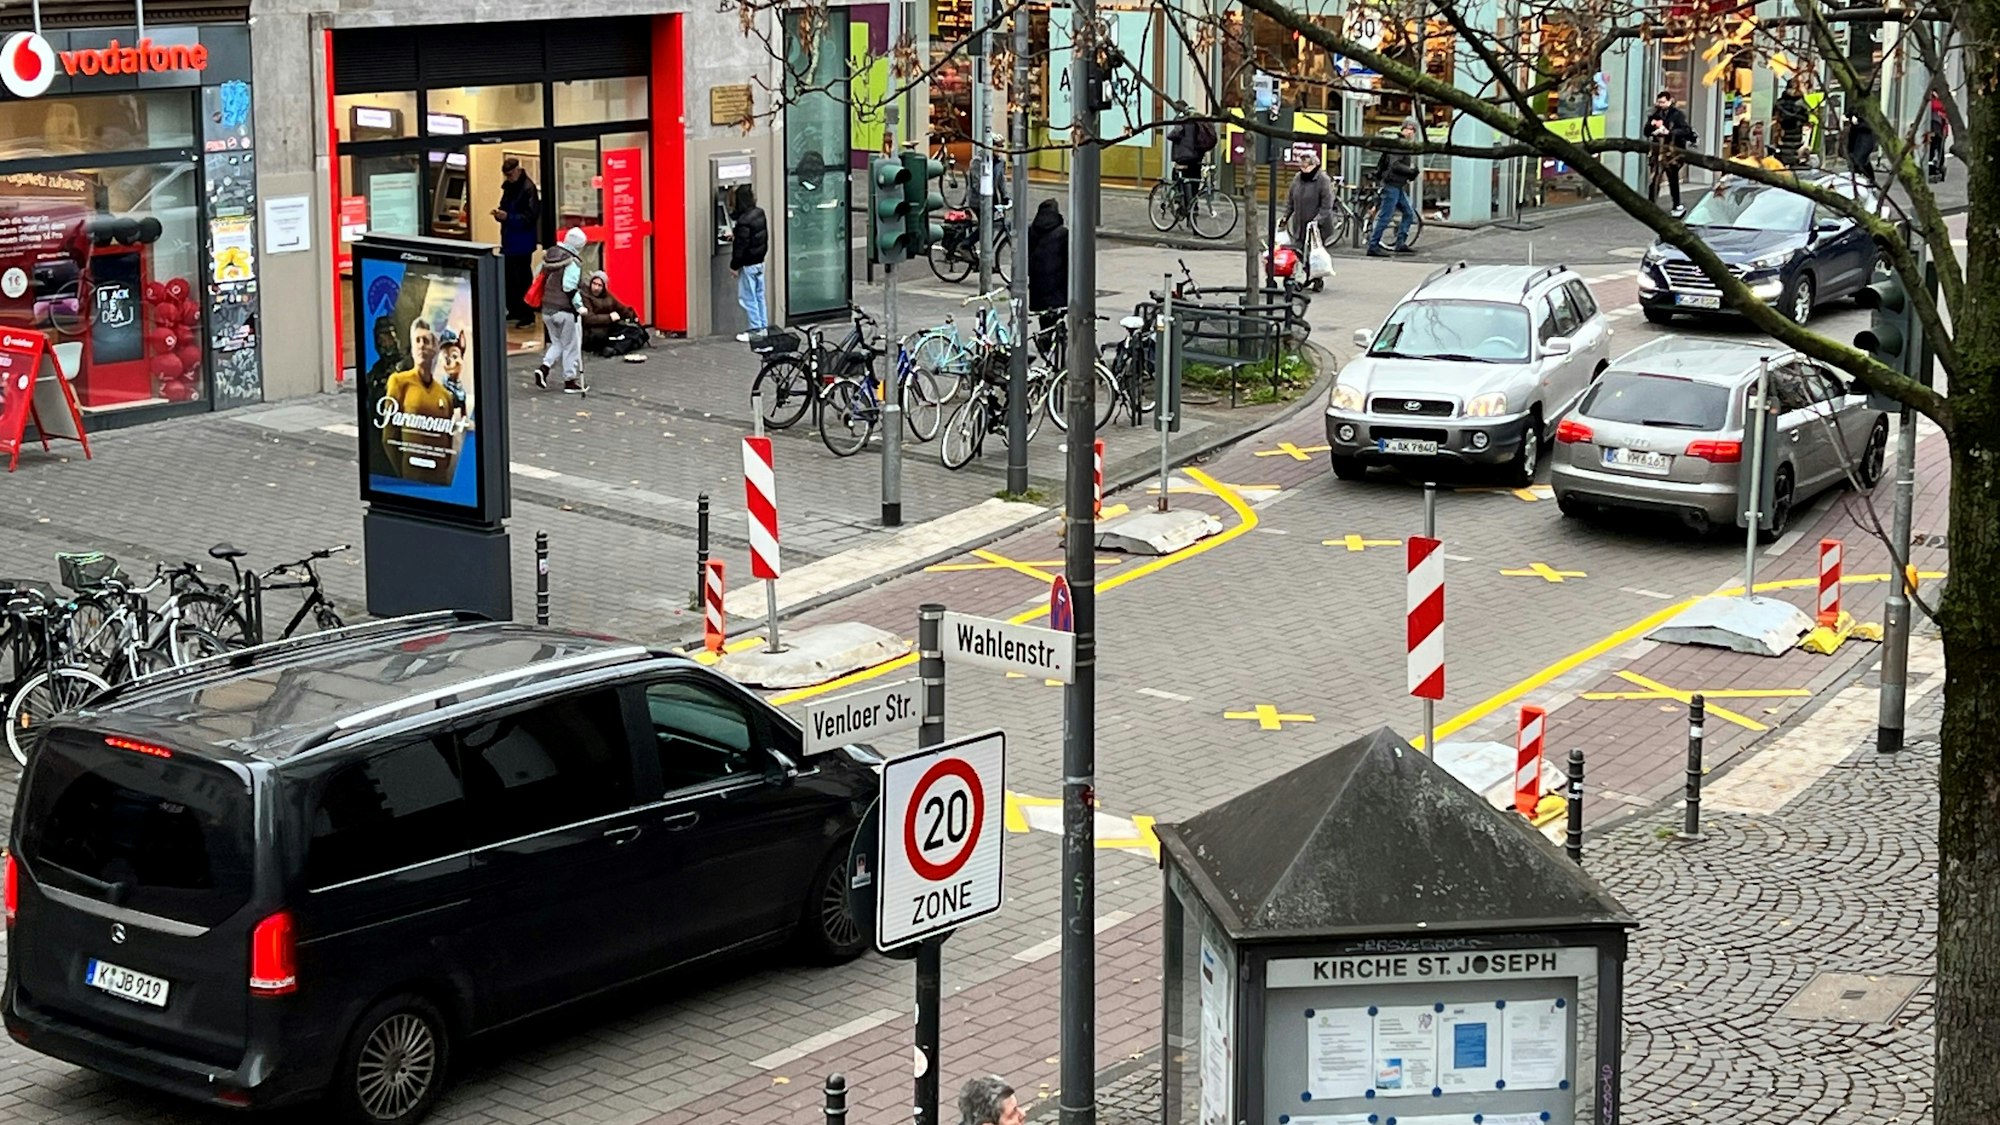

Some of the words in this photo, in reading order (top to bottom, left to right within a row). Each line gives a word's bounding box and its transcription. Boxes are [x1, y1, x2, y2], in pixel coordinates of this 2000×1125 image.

[1353, 18, 1375, 39] 30
[60, 38, 208, 76] vodafone
[373, 395, 470, 436] Paramount+
[957, 622, 1060, 670] Wahlenstr.
[813, 702, 881, 741] Venloer
[885, 693, 916, 723] Str.
[923, 789, 968, 852] 20
[912, 880, 973, 926] ZONE
[1313, 958, 1408, 980] KIRCHE
[1417, 956, 1451, 977] ST.
[1457, 952, 1557, 975] JOSEPH
